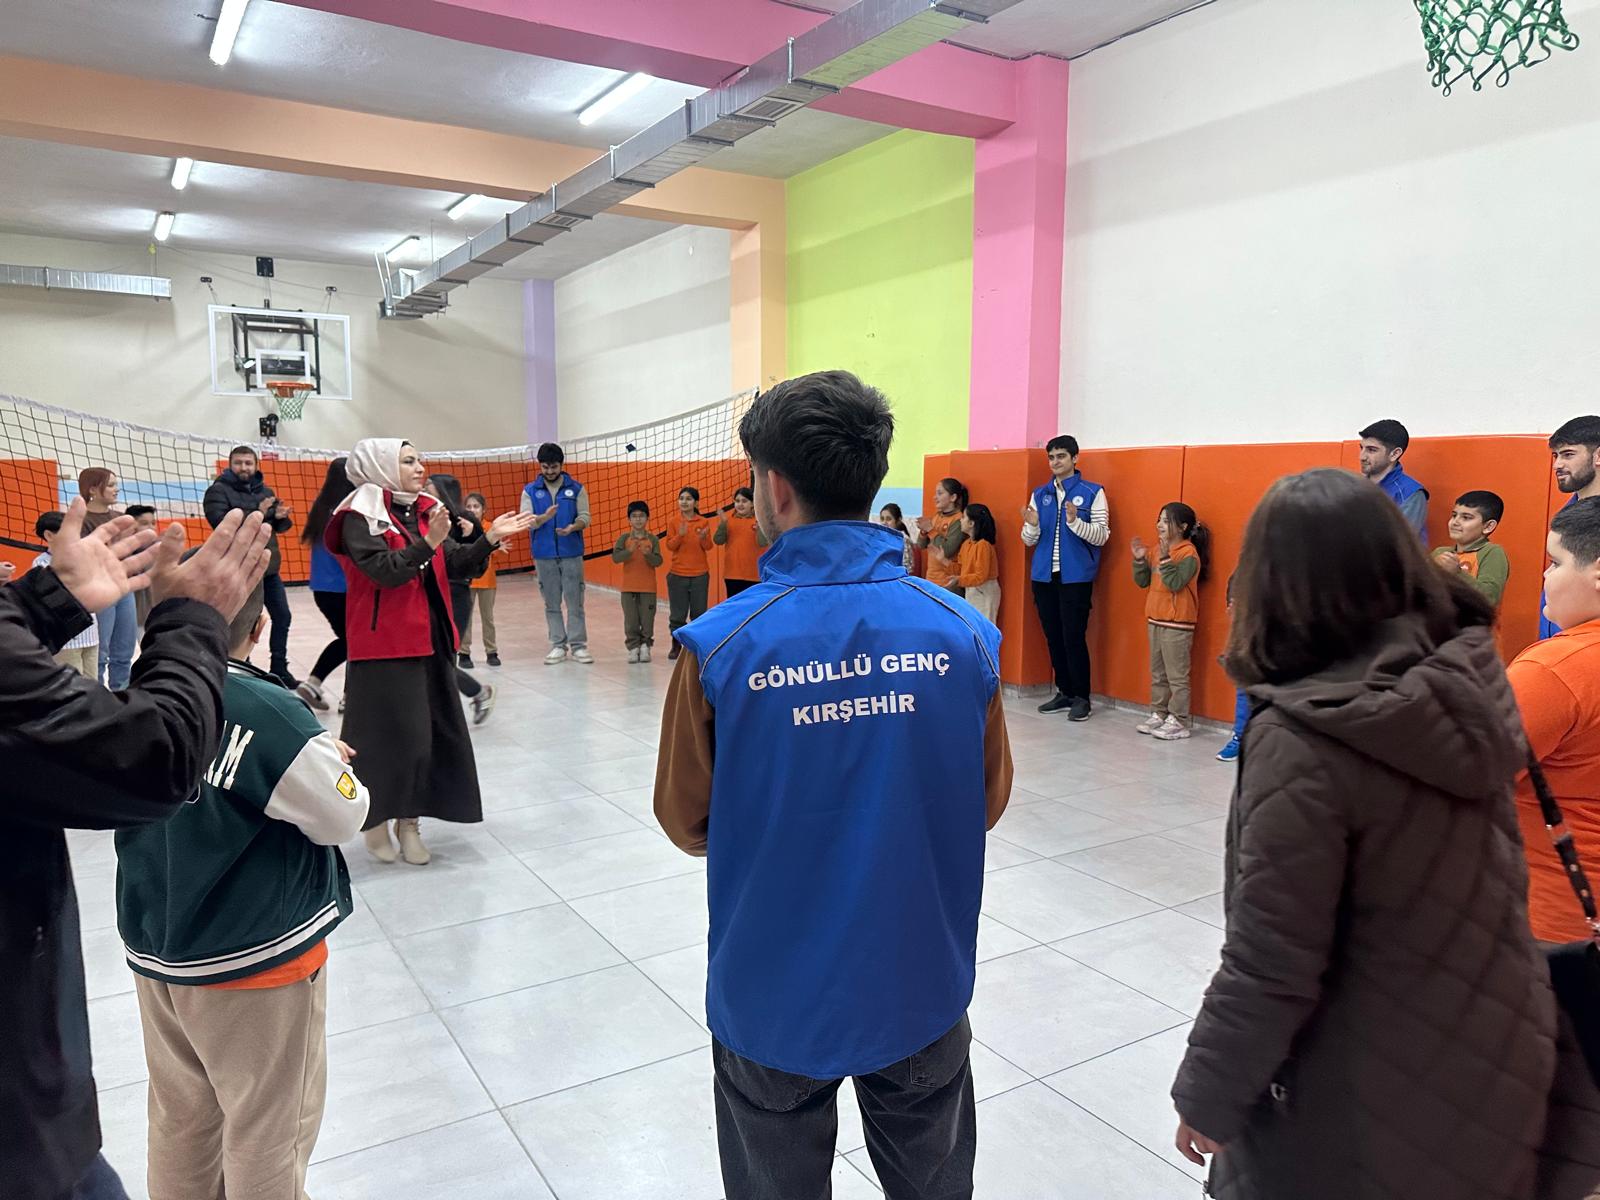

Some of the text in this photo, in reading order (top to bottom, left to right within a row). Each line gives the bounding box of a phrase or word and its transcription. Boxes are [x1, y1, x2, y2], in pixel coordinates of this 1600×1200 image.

[748, 652, 950, 691] GÖNÜLLÜ GENÇ
[793, 690, 915, 726] KIRŞEHİR
